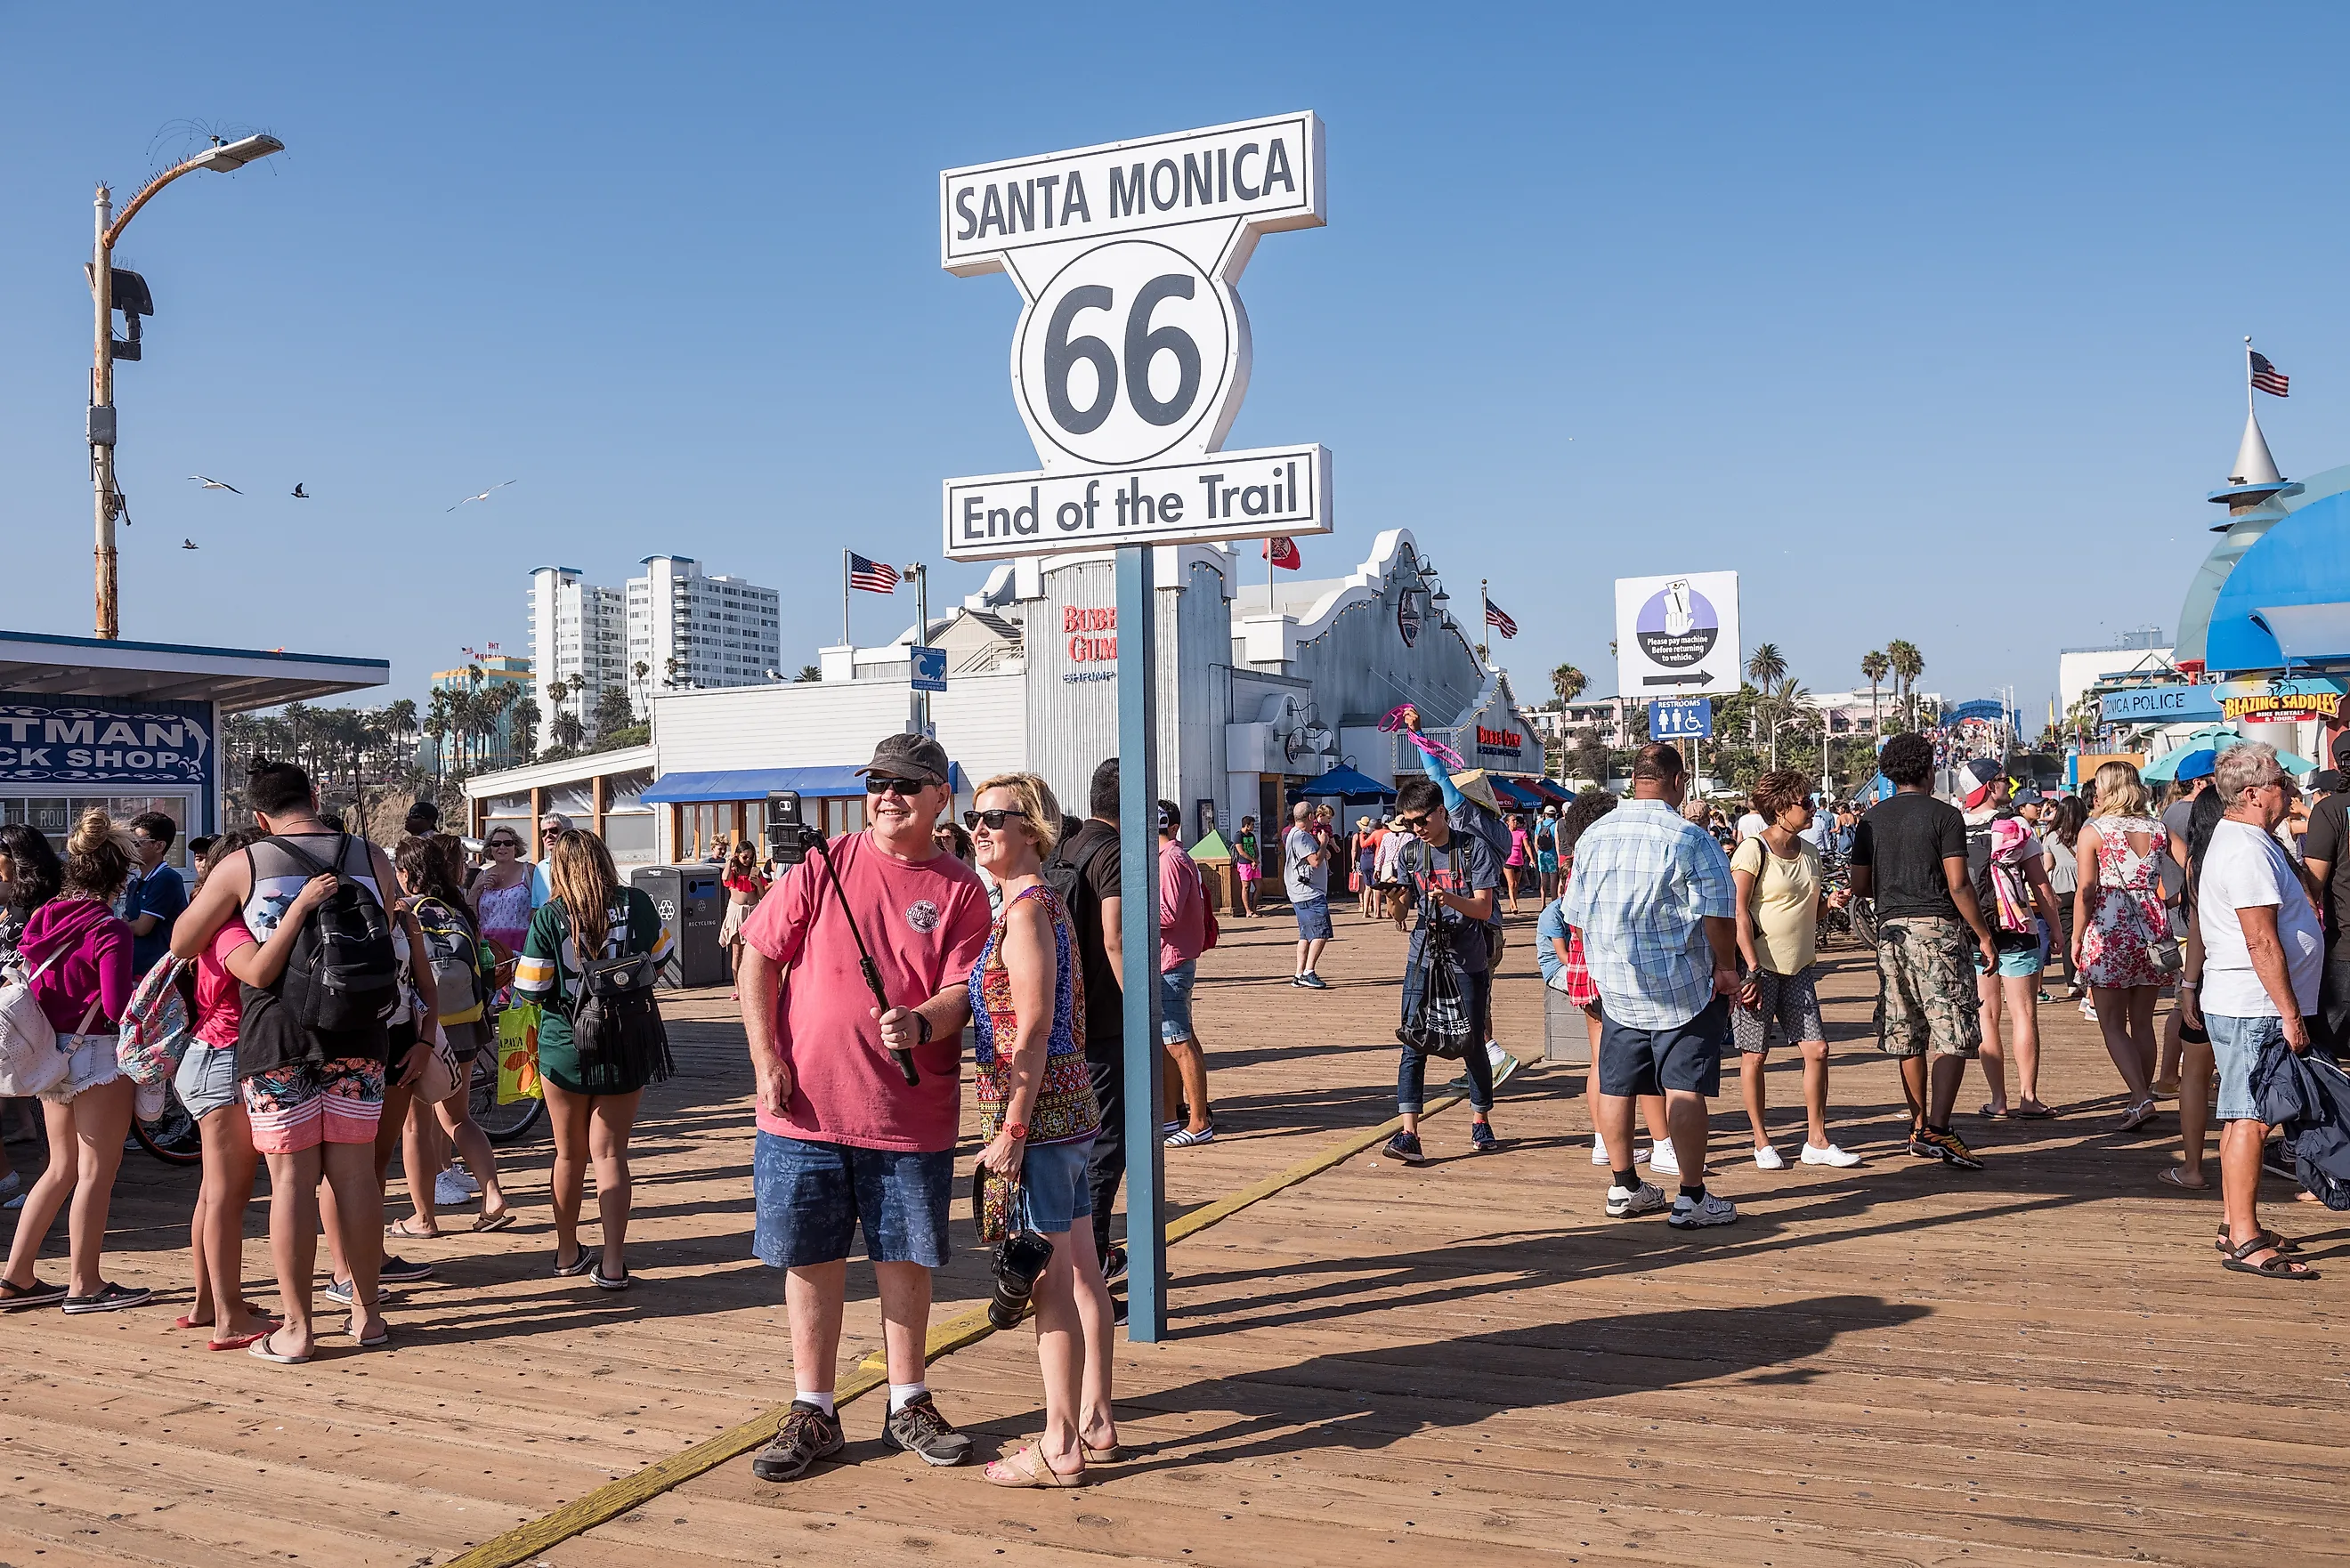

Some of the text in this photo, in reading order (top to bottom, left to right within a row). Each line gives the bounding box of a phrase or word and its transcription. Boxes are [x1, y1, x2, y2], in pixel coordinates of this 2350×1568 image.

[955, 137, 1296, 241] SANTA MONICA
[1043, 273, 1202, 435] 66
[963, 462, 1297, 539] End of the Trail
[1063, 605, 1118, 633] BUBB
[1068, 634, 1118, 662] GUM
[1647, 635, 1708, 646] Please pay machine
[1651, 644, 1705, 654] Before returning
[1662, 652, 1695, 662] to vehicle.
[1062, 671, 1116, 683] SHRIMP
[1657, 699, 1701, 708] RESTROOMS
[2133, 692, 2186, 712] POLICE
[2224, 692, 2338, 721] BLAZING SADDLES
[0, 716, 183, 748] TMAN
[66, 748, 180, 769] SHOP
[688, 919, 717, 927] RECYCLING
[905, 908, 940, 928] COLORADO
